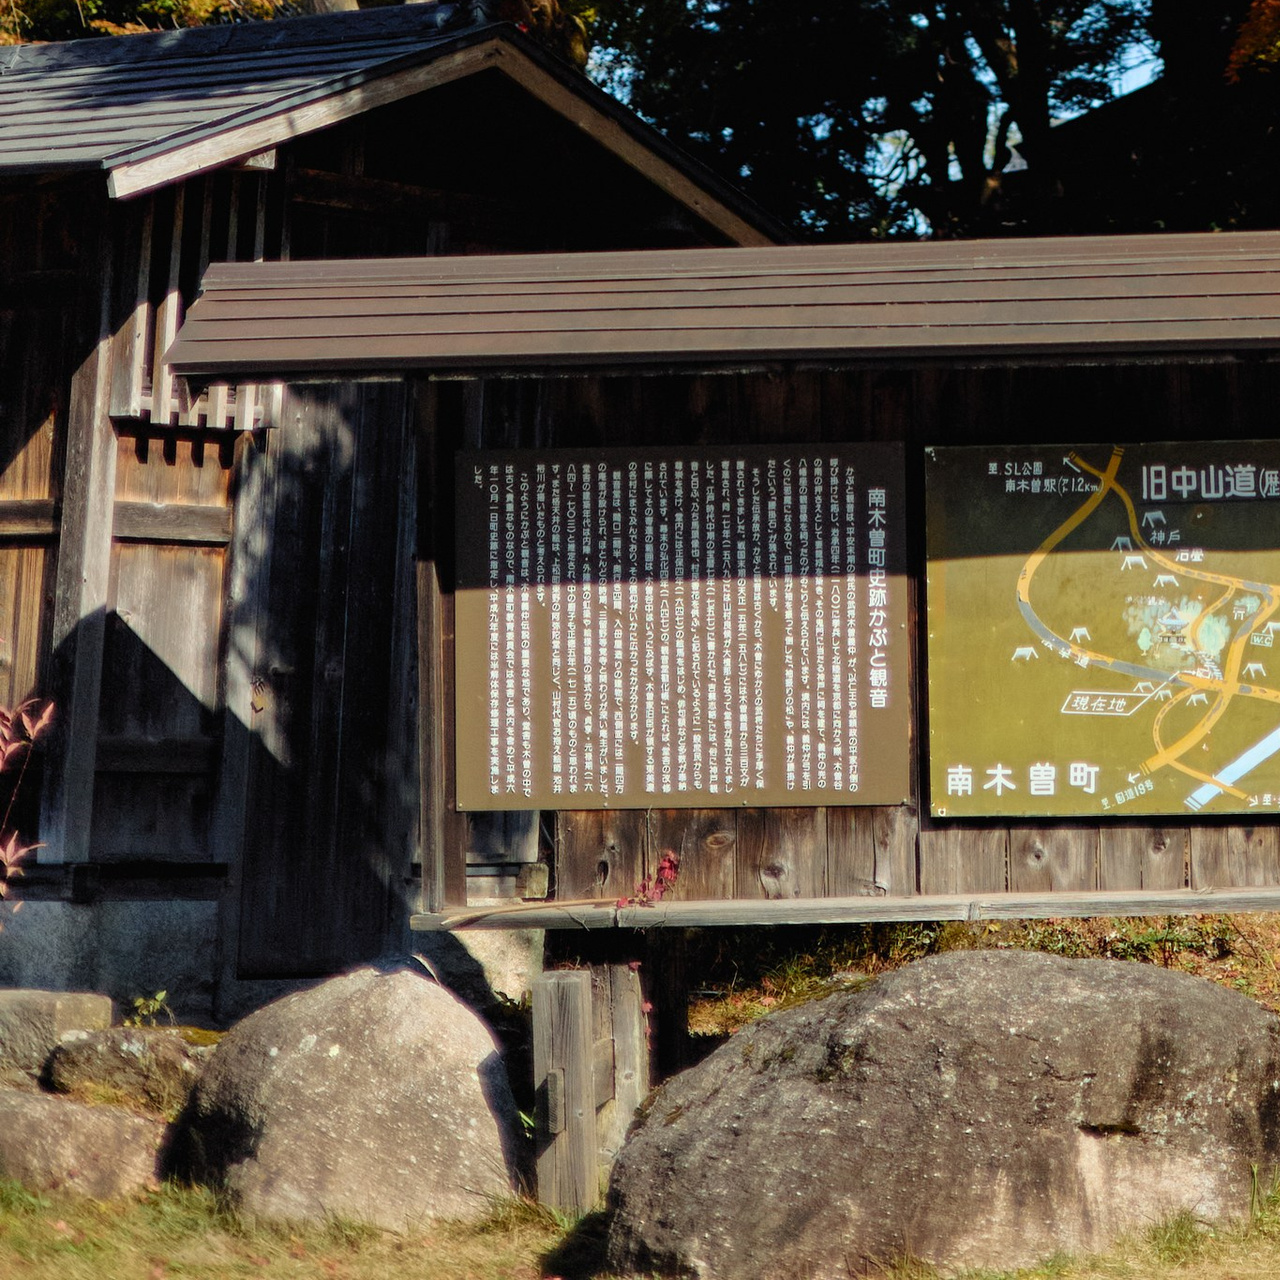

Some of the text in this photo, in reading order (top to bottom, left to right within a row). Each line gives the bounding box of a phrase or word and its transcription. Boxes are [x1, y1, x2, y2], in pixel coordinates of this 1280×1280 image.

[473, 465, 484, 489] した。
[1150, 530, 1180, 545] 神戸
[867, 487, 888, 709] 南木曽町史跡かぶと観音
[1071, 695, 1127, 712] 現在地
[947, 762, 1100, 797] 南木曽町
